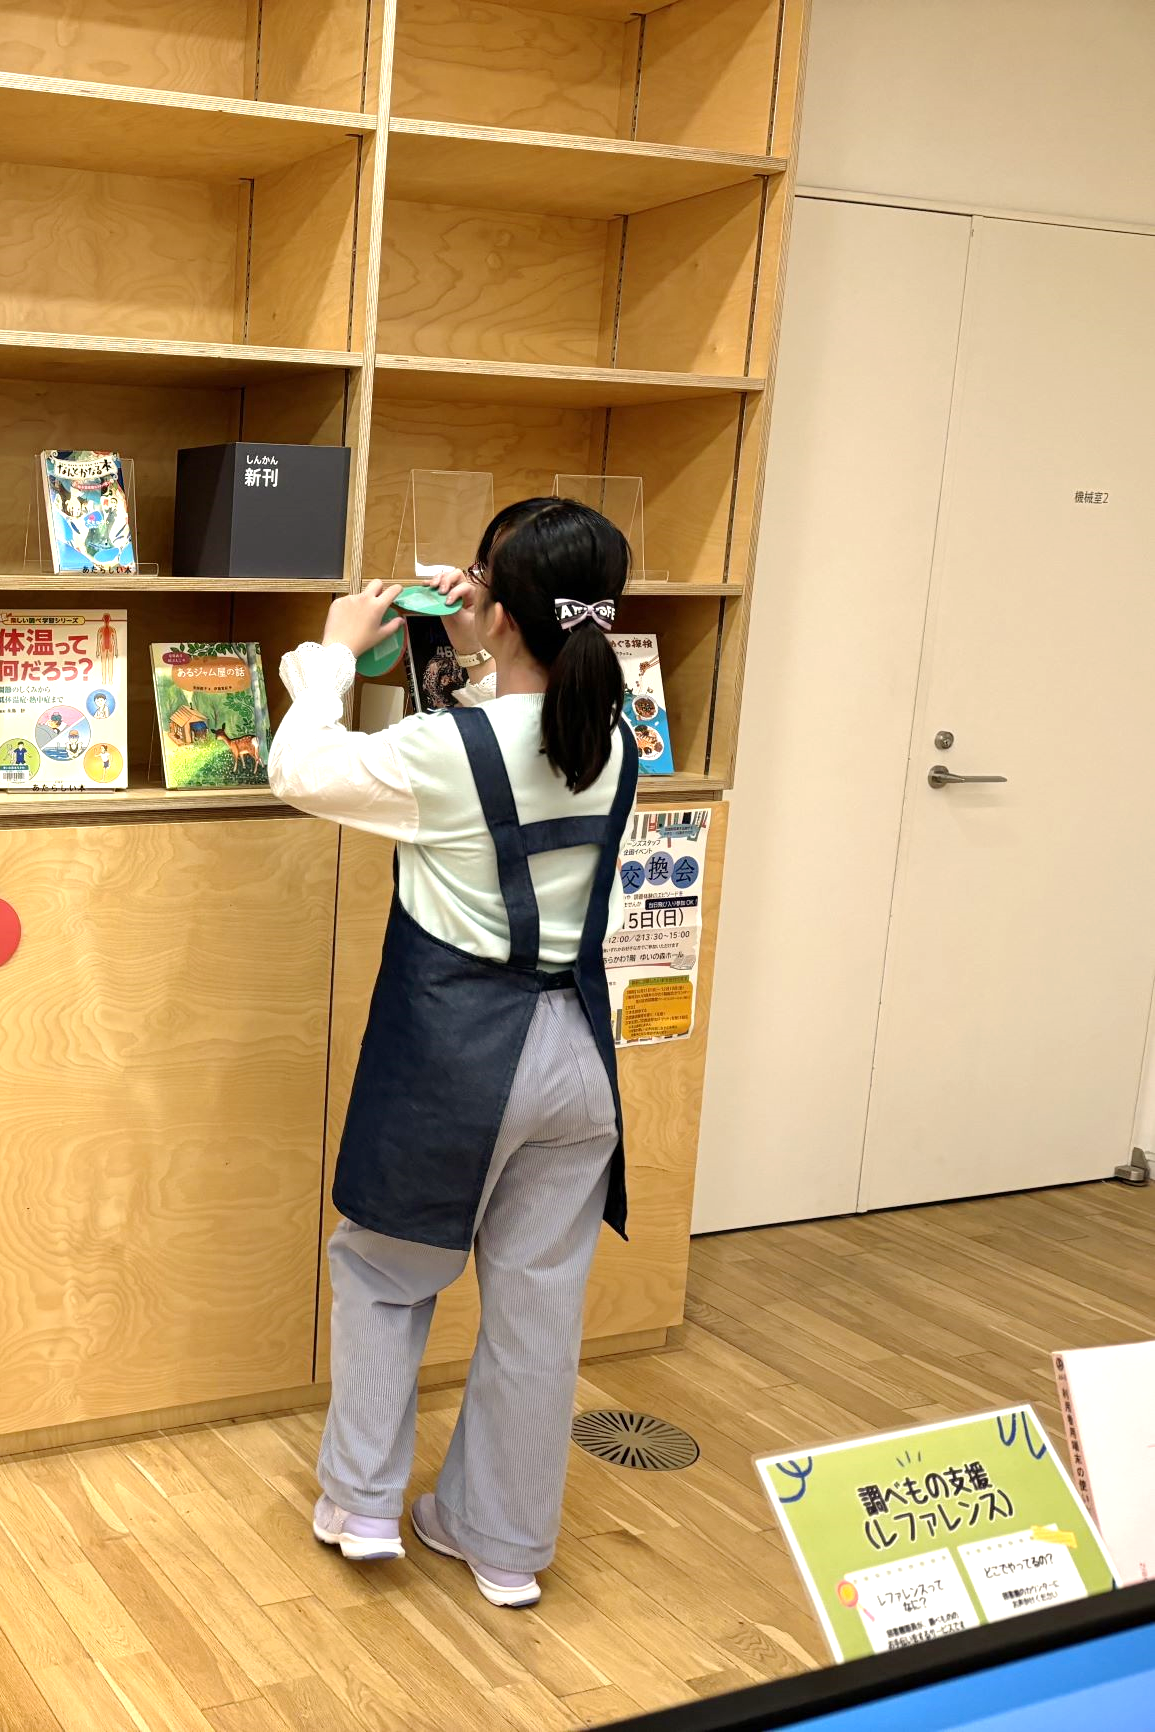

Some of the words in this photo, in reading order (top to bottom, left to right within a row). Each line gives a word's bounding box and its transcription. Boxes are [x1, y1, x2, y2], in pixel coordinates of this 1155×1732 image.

[246, 454, 279, 465] しんかん
[244, 468, 279, 487] 新刊
[1074, 490, 1109, 504] 機械室2
[177, 666, 245, 678] あるジャム屋の話
[32, 784, 86, 792] あたらしい本
[621, 856, 695, 889] 交換会
[857, 1461, 993, 1517] 調べもの支援
[865, 1489, 1014, 1549] (レファレンス)
[877, 1580, 944, 1606] レファレンスって
[903, 1597, 927, 1612] なに?
